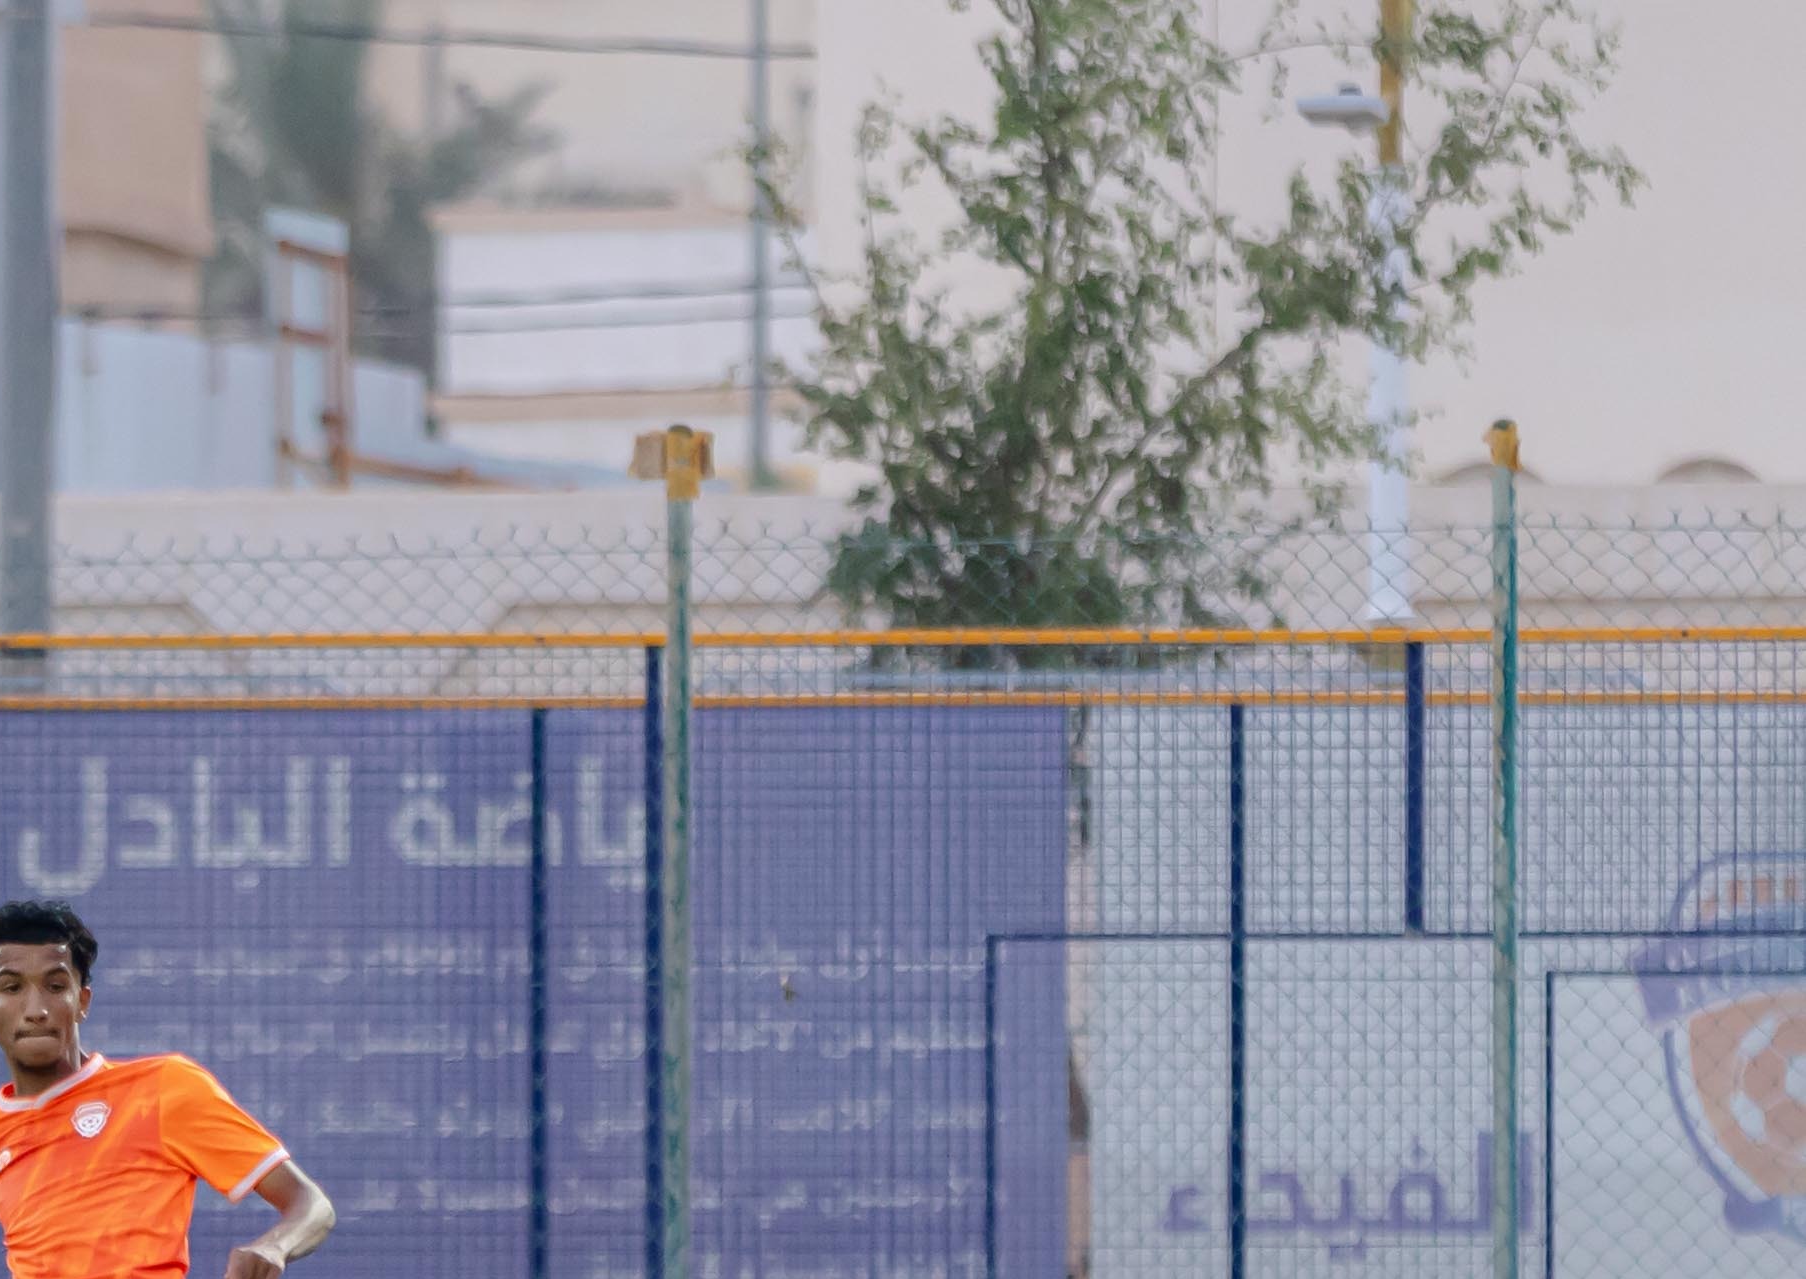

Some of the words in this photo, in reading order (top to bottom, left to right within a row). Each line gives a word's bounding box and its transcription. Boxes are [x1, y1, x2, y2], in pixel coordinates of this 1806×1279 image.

[18, 755, 350, 896] البادل
[391, 757, 652, 893] ياضة
[1163, 1132, 1533, 1261] الفيحء
